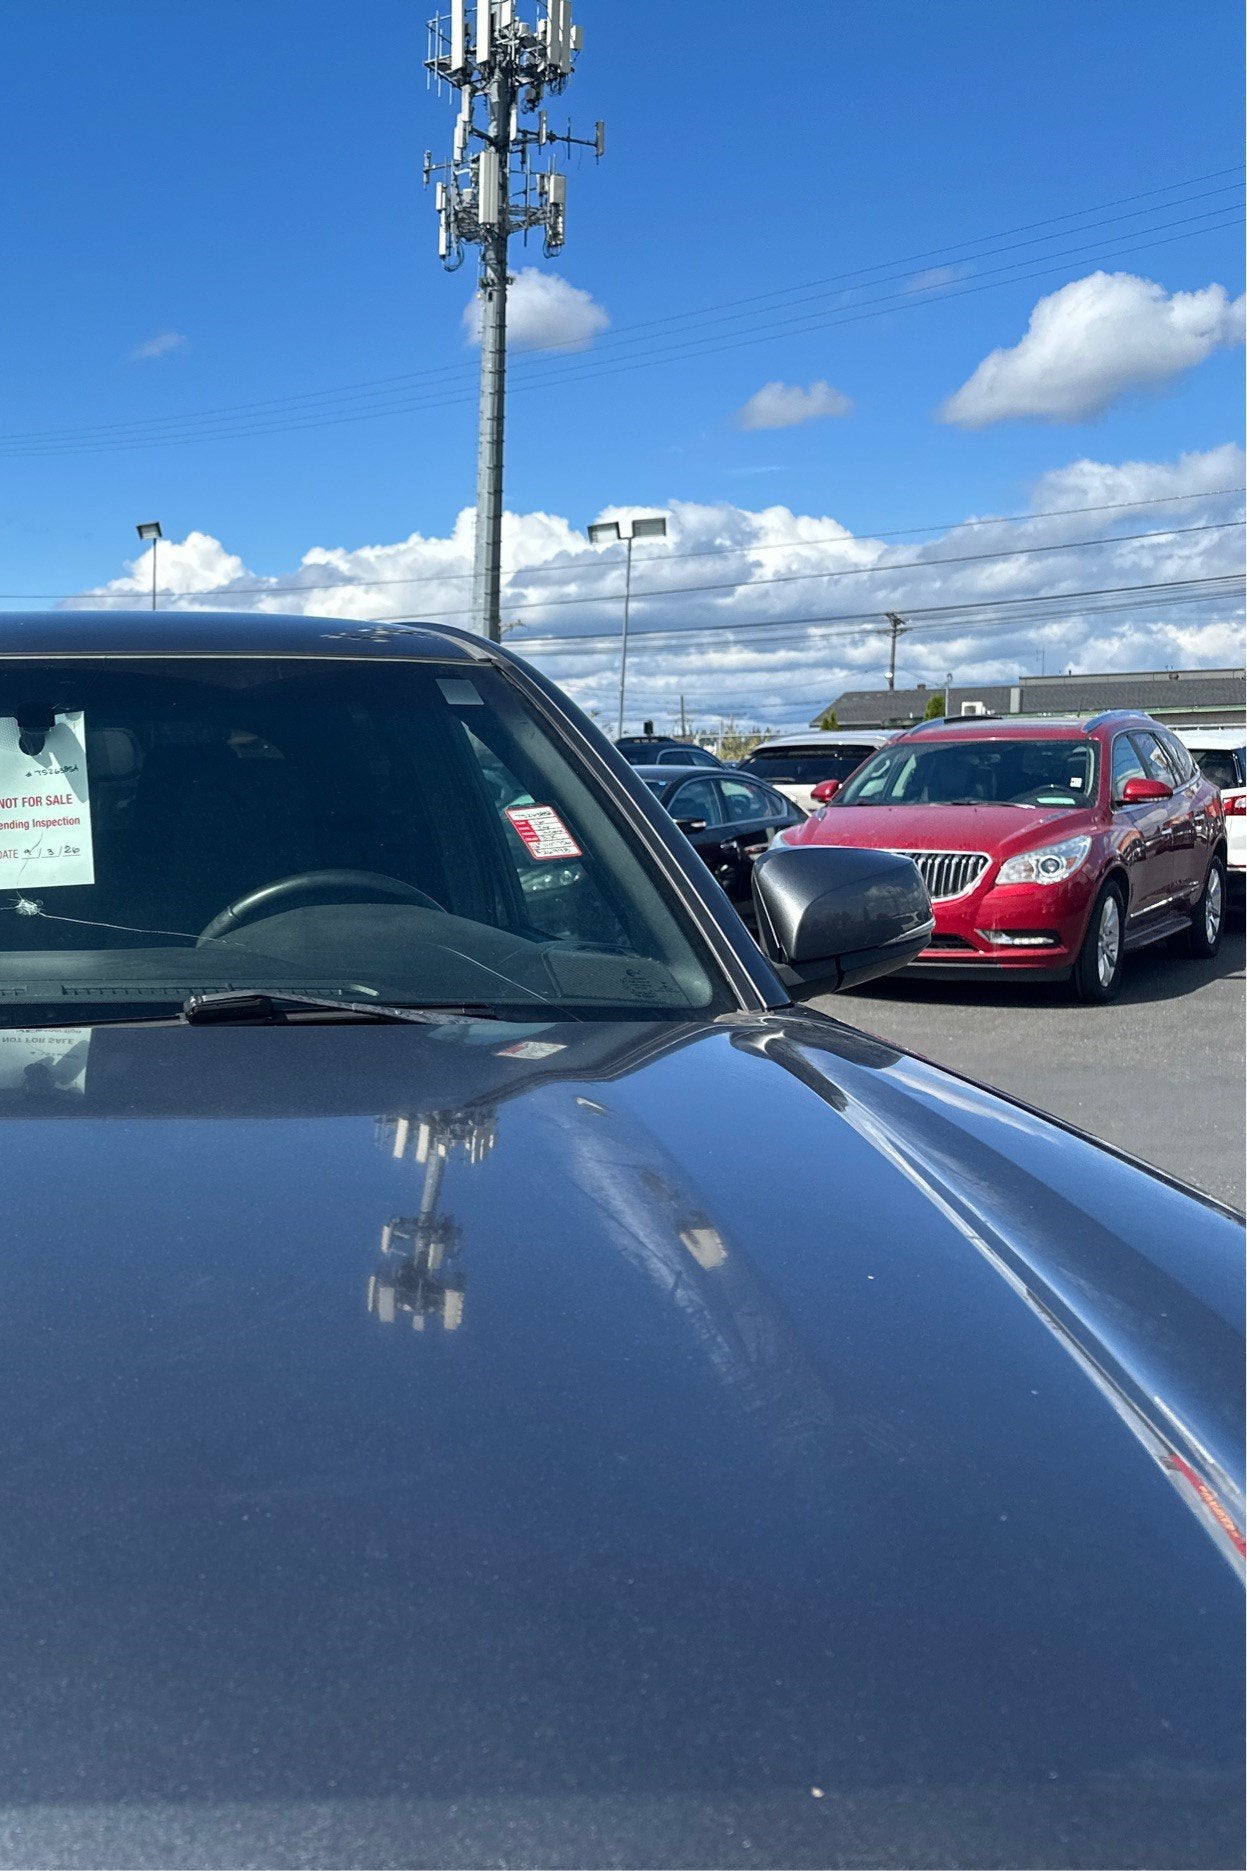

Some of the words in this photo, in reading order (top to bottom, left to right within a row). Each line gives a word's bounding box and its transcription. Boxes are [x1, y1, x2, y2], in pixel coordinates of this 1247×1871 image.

[22, 796, 43, 808] FOR
[46, 794, 73, 806] SALE
[32, 816, 81, 829] Inspection
